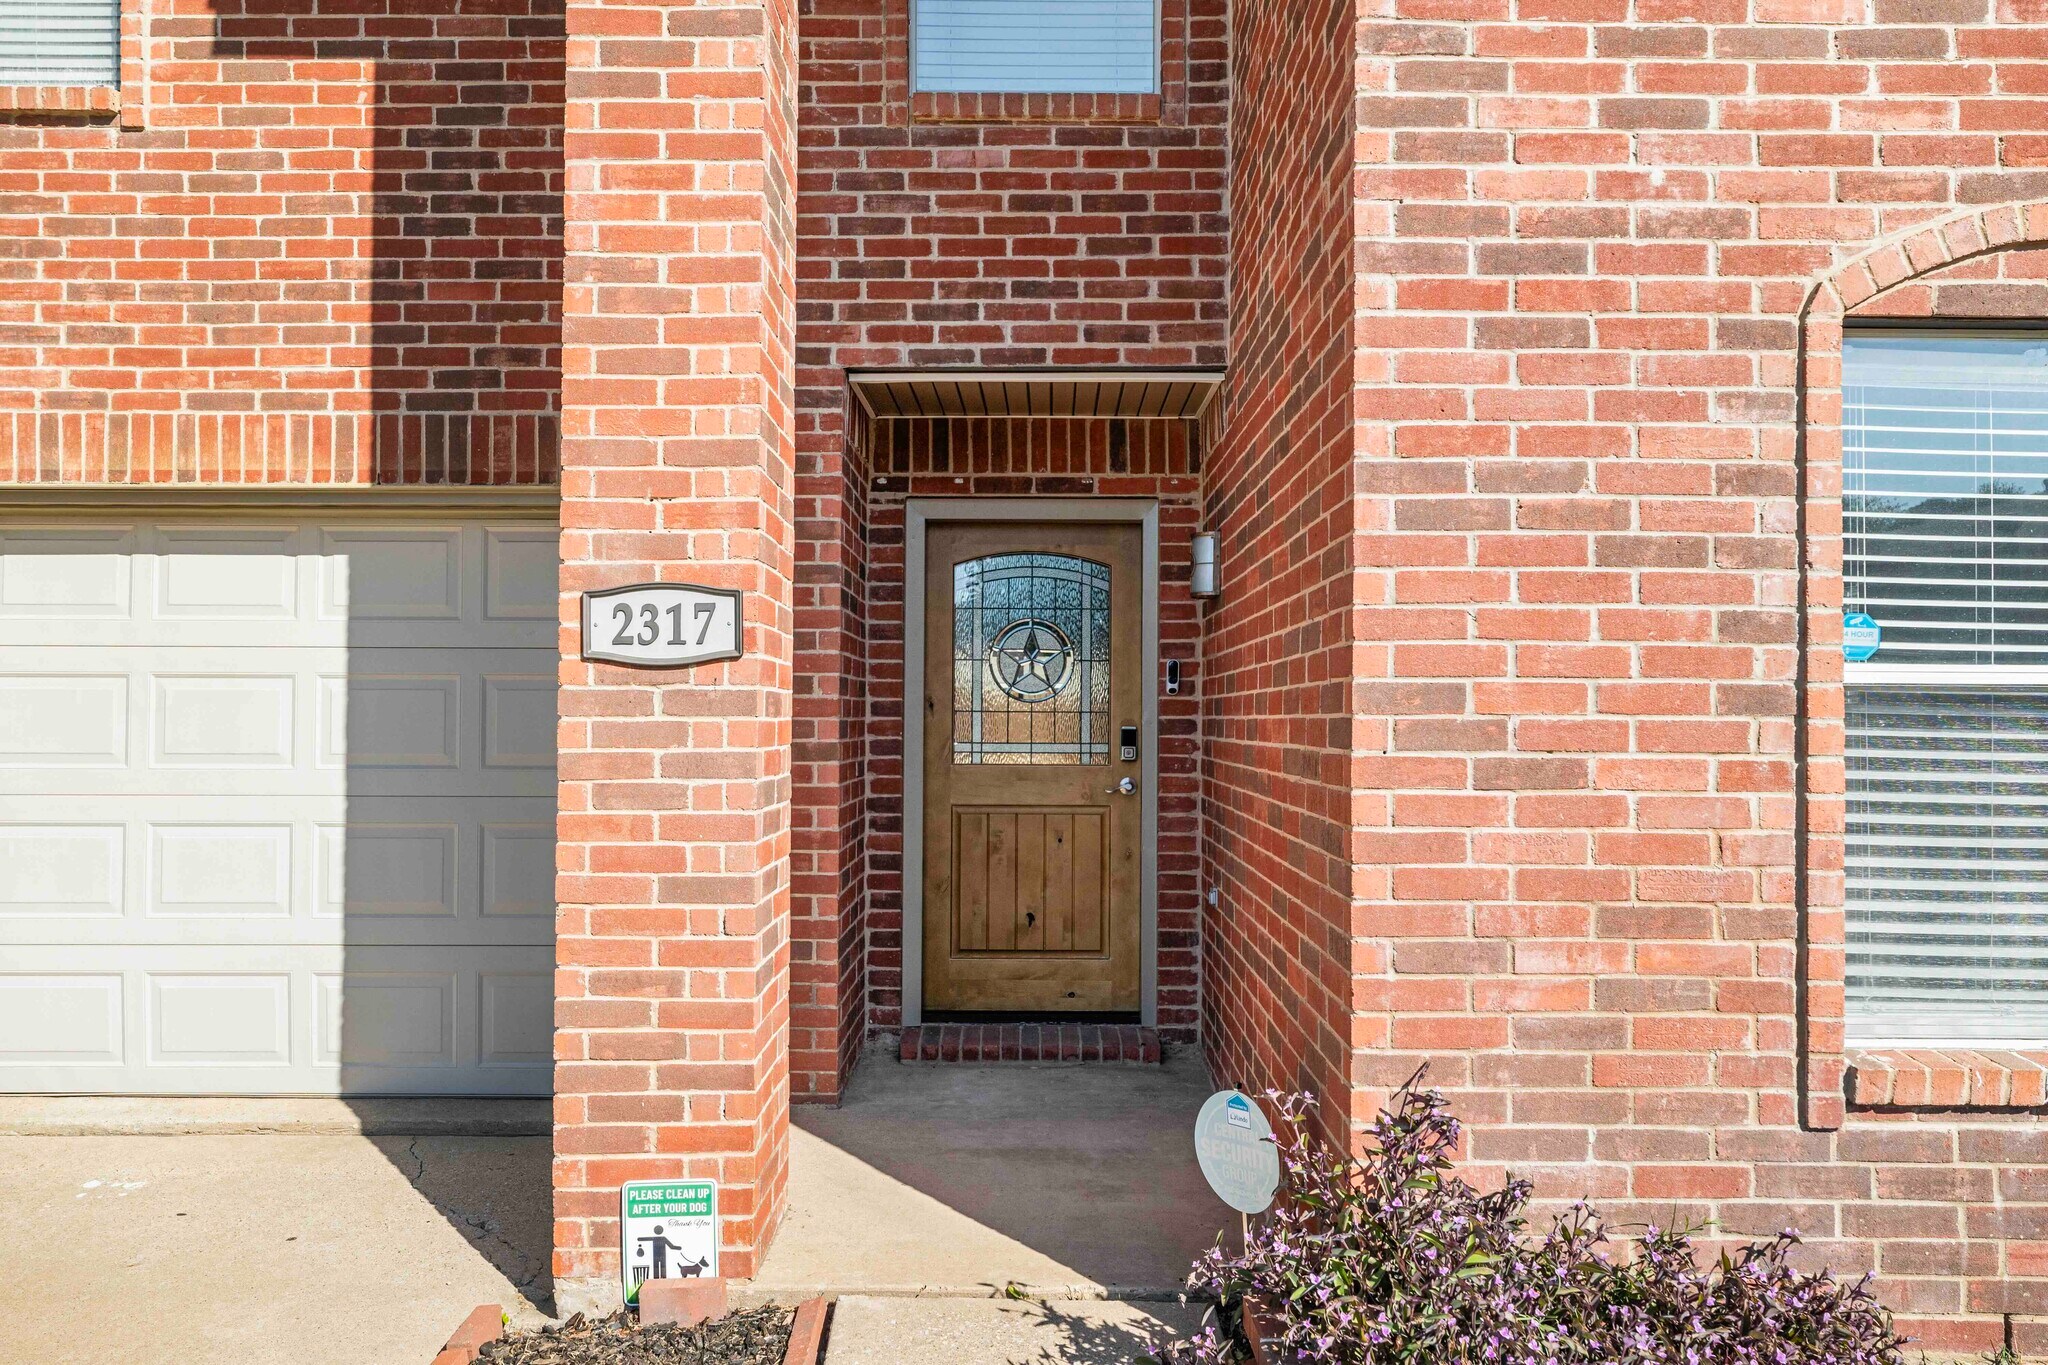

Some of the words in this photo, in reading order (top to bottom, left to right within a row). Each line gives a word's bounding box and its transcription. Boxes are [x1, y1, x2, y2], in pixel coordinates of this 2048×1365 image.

[612, 602, 716, 646] 2317
[1200, 1137, 1274, 1173] SECURITY
[1222, 1165, 1257, 1185] GROUP
[629, 1190, 664, 1201] PLEASE
[666, 1189, 695, 1199] CLEAN
[698, 1188, 710, 1199] UP
[632, 1204, 661, 1214] AFTER
[663, 1203, 687, 1213] YOUR
[689, 1203, 707, 1213] DOG
[667, 1218, 692, 1227] Thank
[693, 1218, 711, 1229] You
